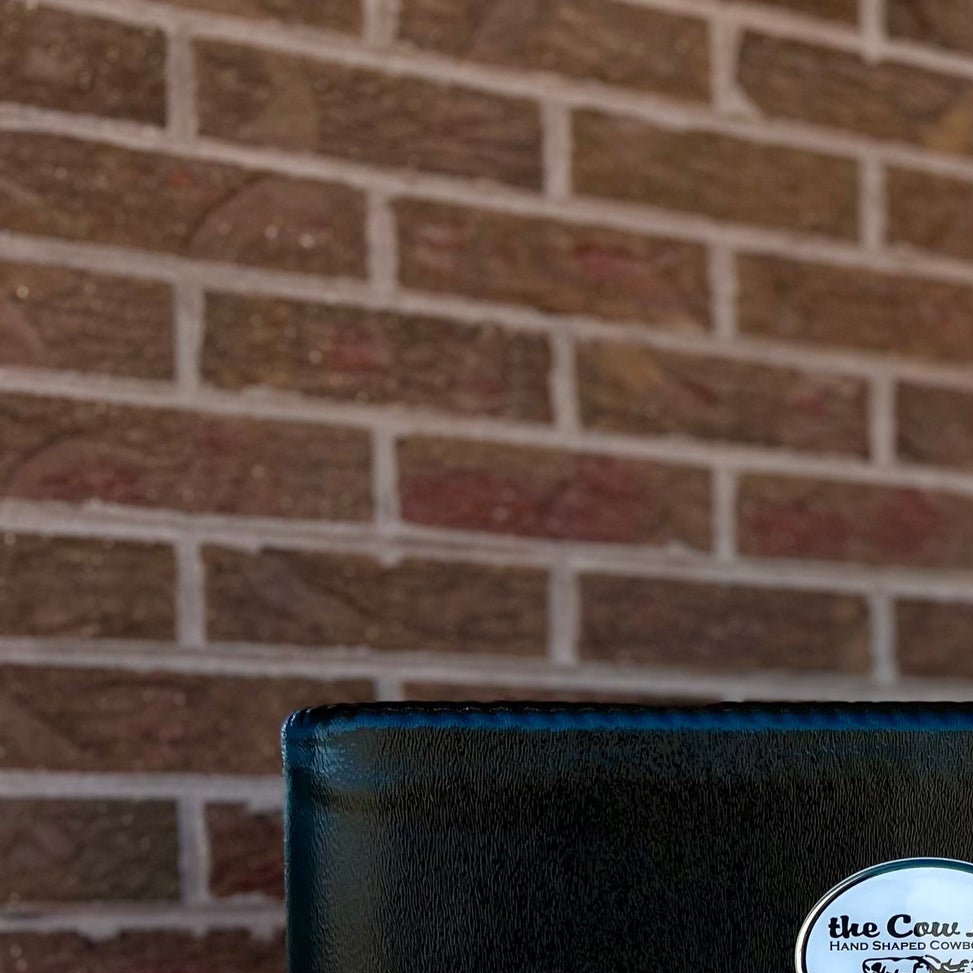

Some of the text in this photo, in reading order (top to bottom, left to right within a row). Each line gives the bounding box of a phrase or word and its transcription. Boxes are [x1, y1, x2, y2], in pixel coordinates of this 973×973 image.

[828, 914, 880, 939] the
[886, 913, 960, 937] Cow
[829, 940, 869, 951] HAND
[872, 940, 926, 951] SHAPED
